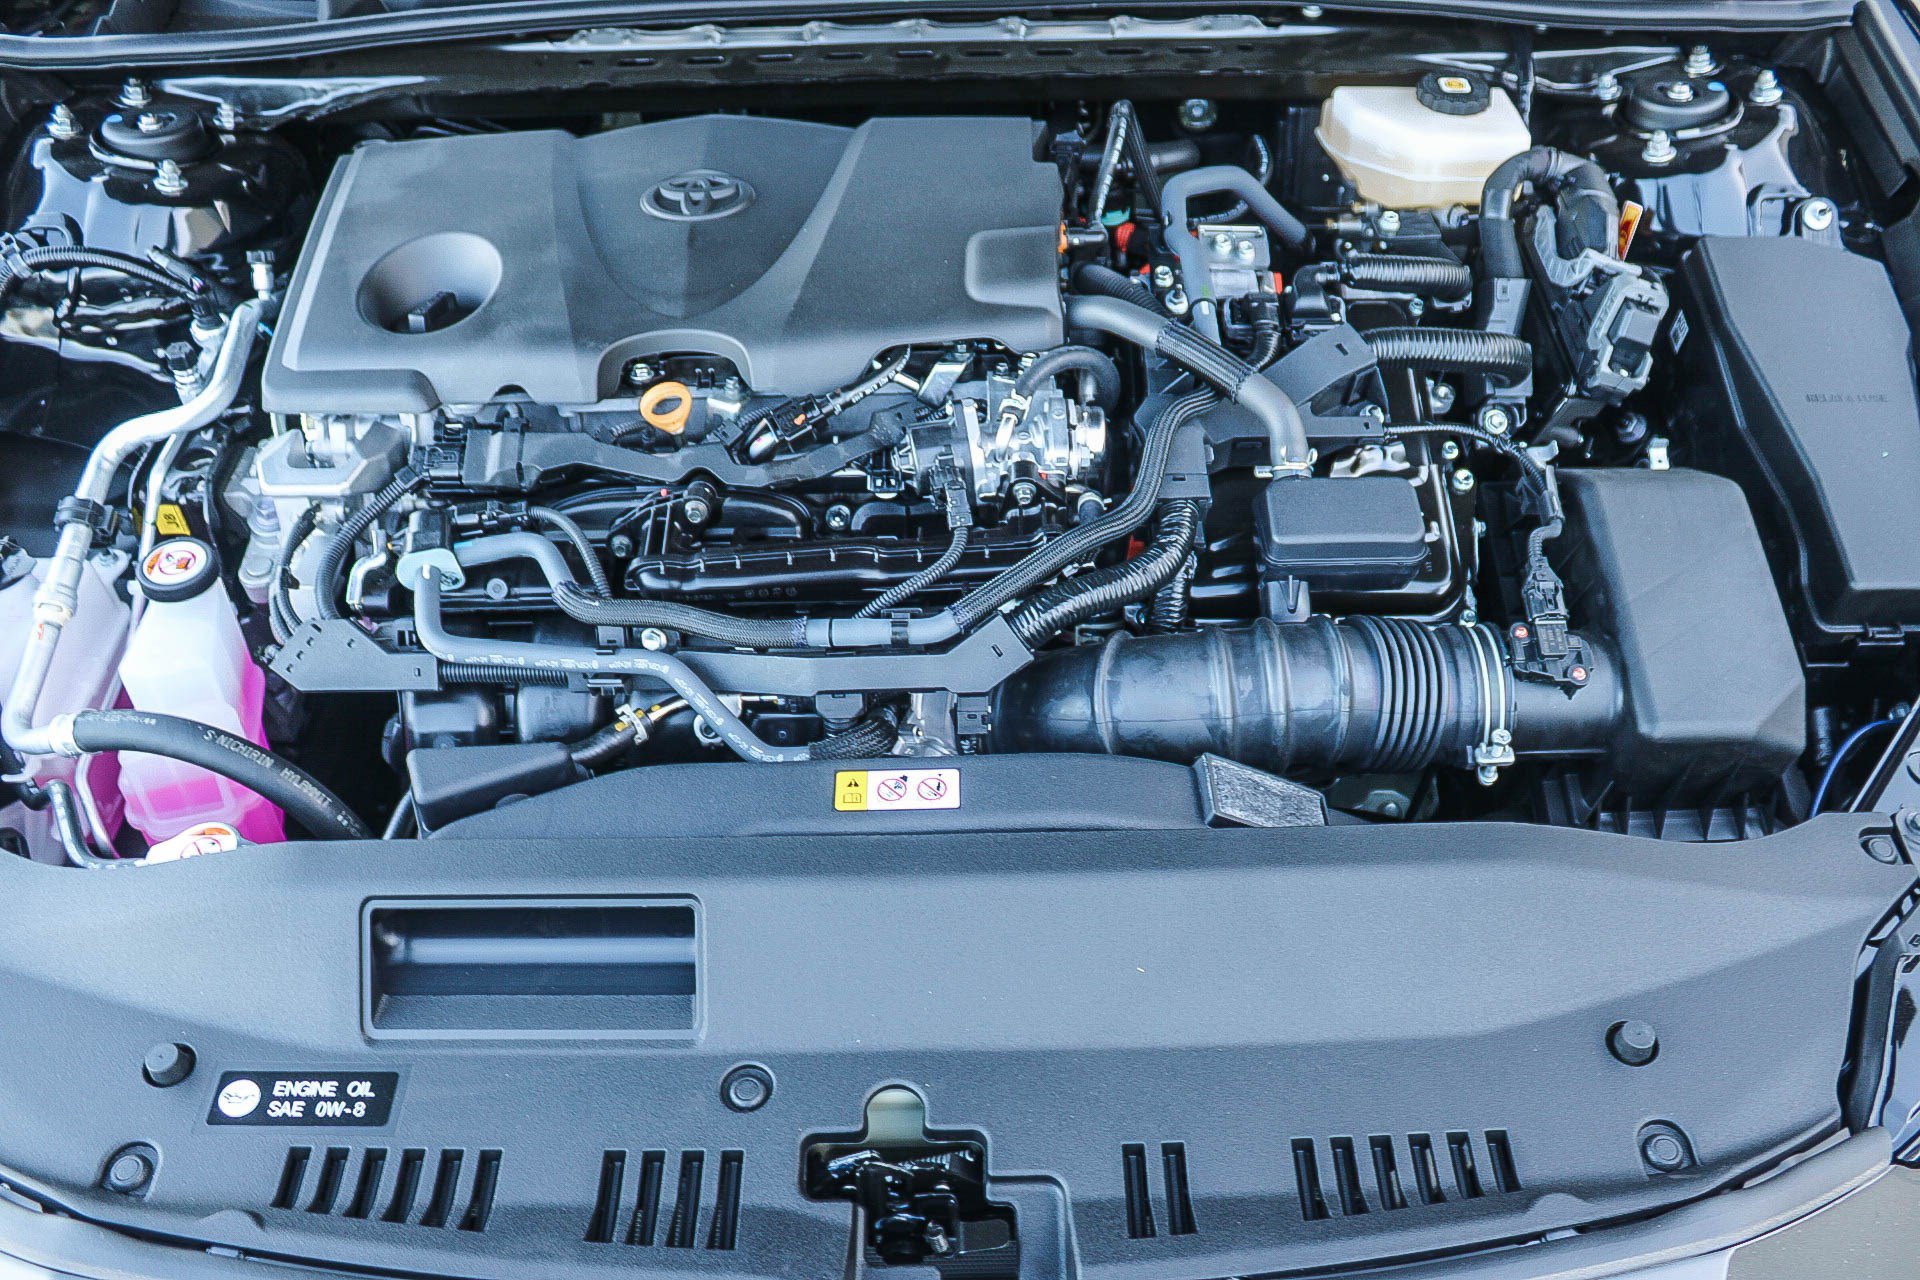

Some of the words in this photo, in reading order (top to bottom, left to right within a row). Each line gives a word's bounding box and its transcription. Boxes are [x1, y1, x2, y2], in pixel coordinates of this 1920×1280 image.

[272, 1080, 339, 1098] ENGINE
[346, 1081, 376, 1098] OIL
[267, 1101, 306, 1118] SAE
